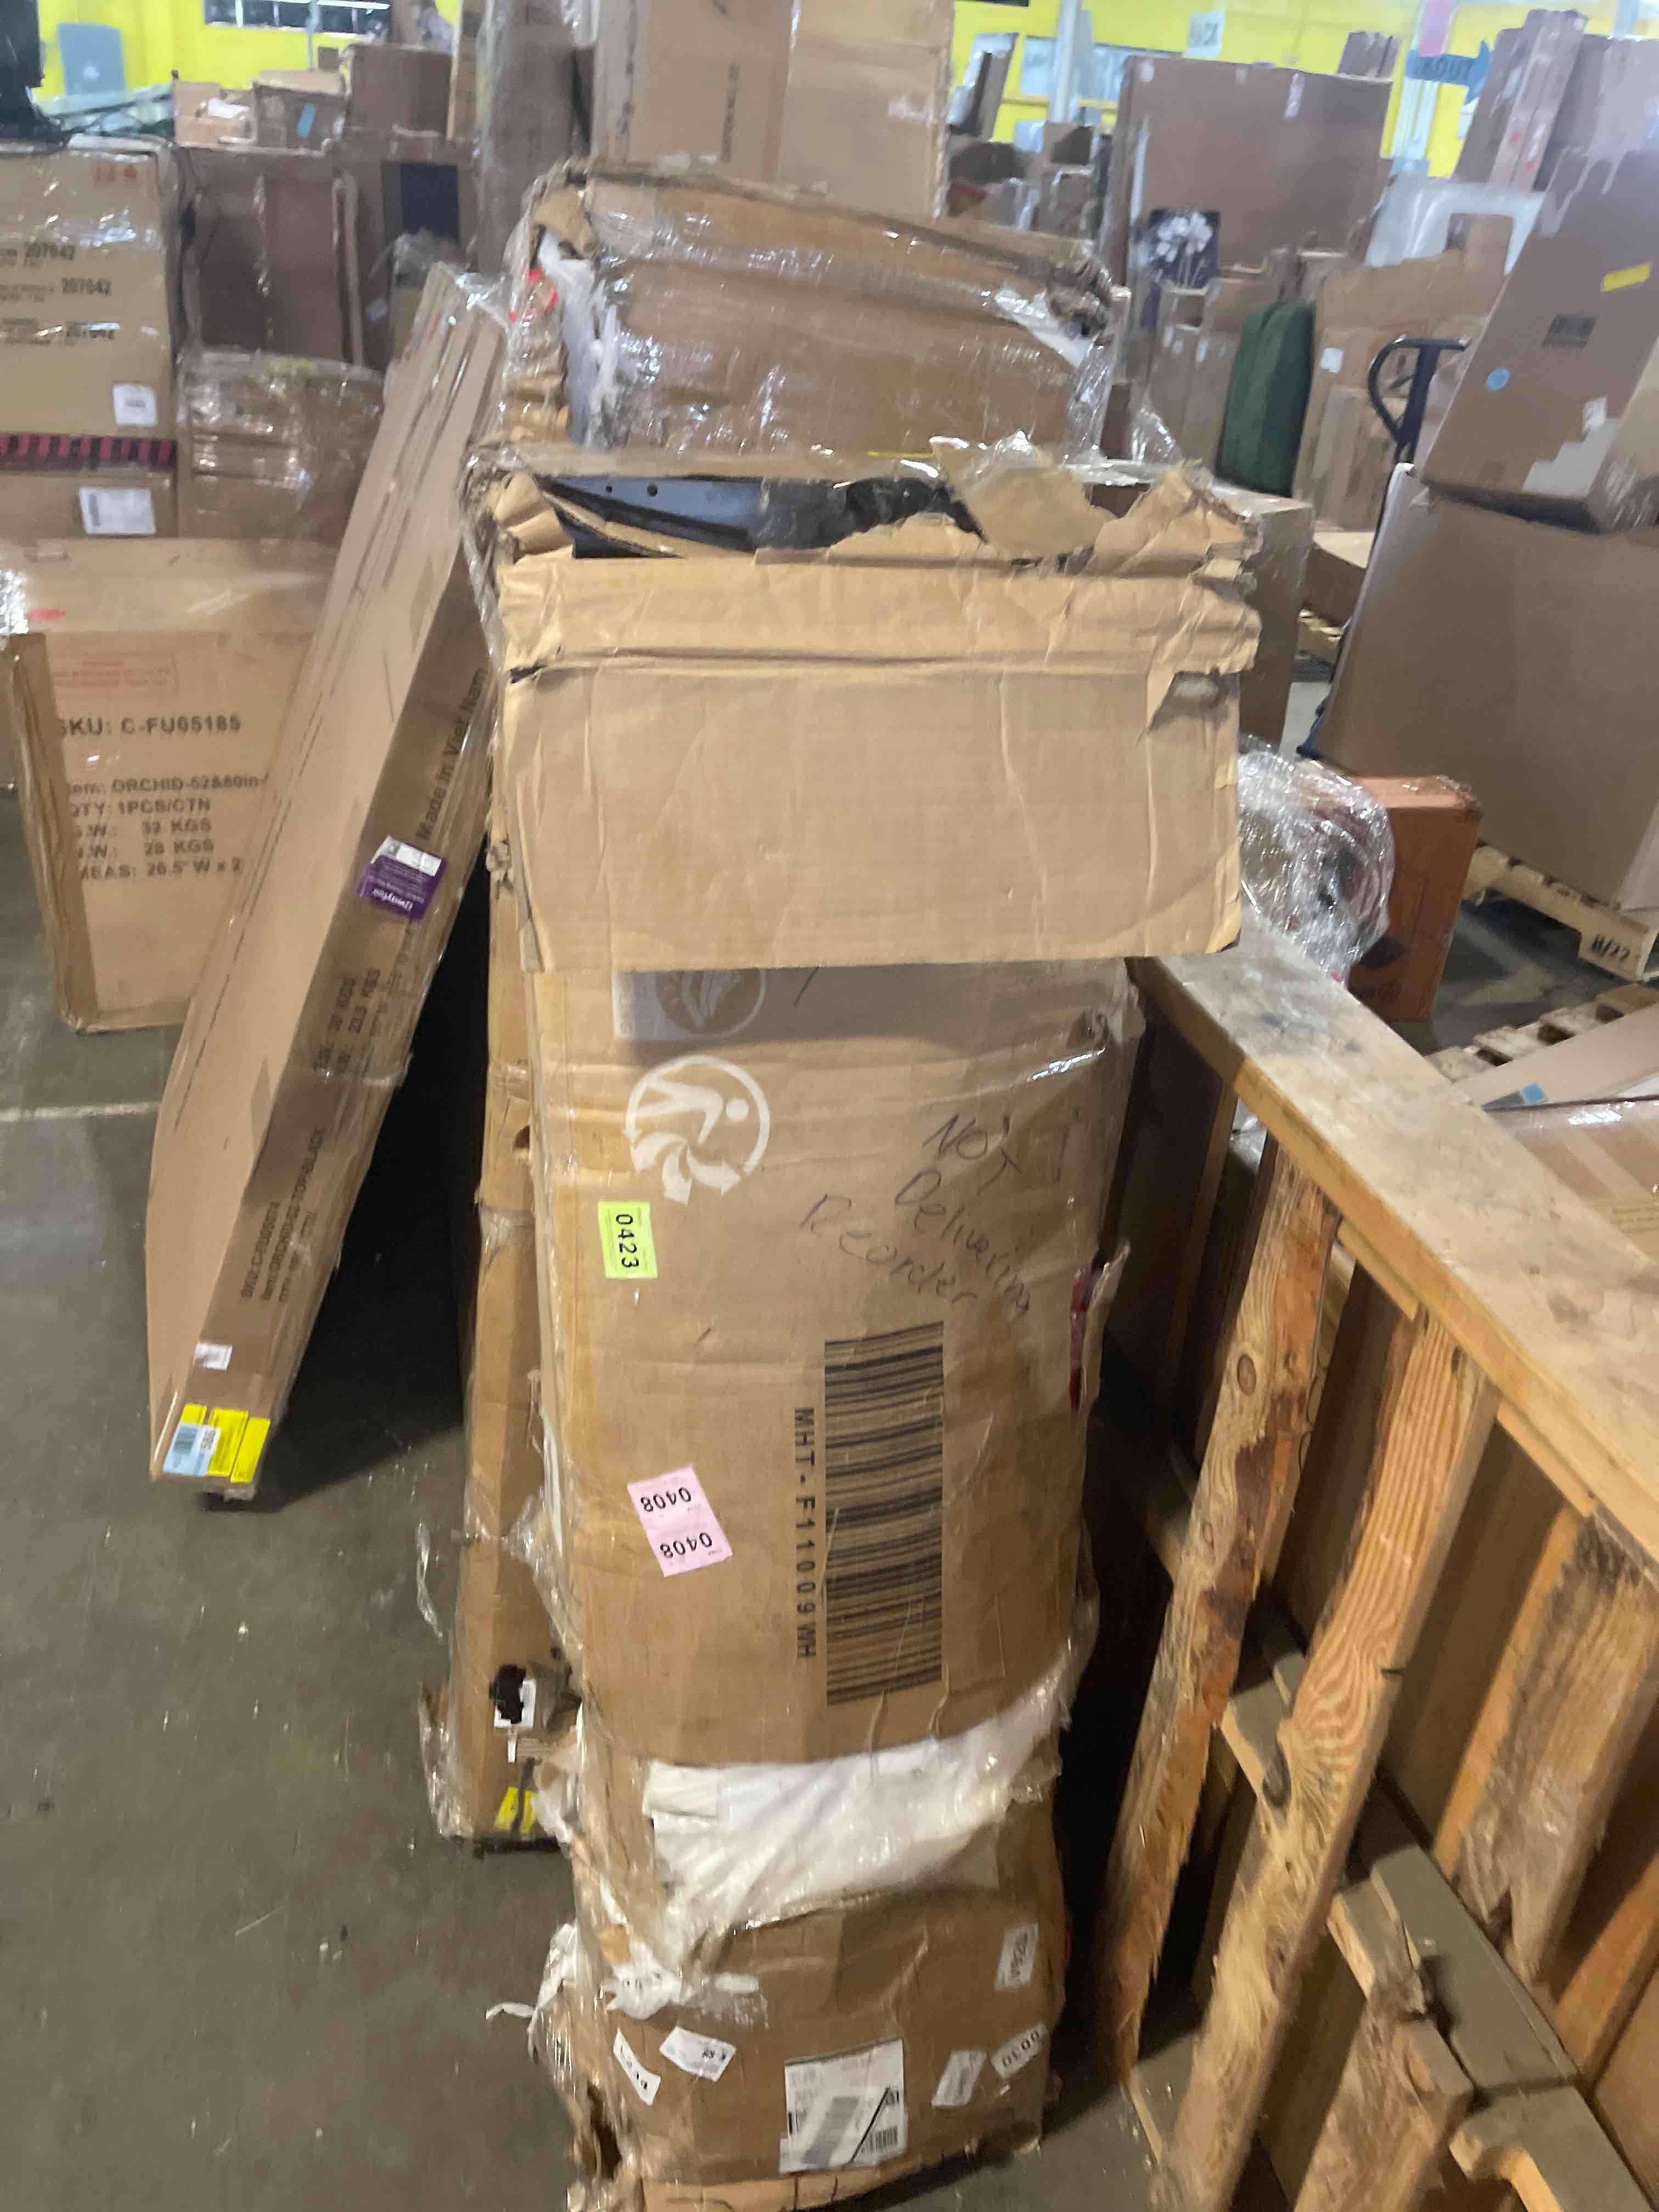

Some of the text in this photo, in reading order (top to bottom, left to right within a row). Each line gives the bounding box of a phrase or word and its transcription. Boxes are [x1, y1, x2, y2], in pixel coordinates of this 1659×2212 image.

[616, 1214, 640, 1268] 0423
[640, 1487, 691, 1513] 0408
[660, 1532, 712, 1559] 0408
[794, 1408, 816, 1660] MHT-F11009WH
